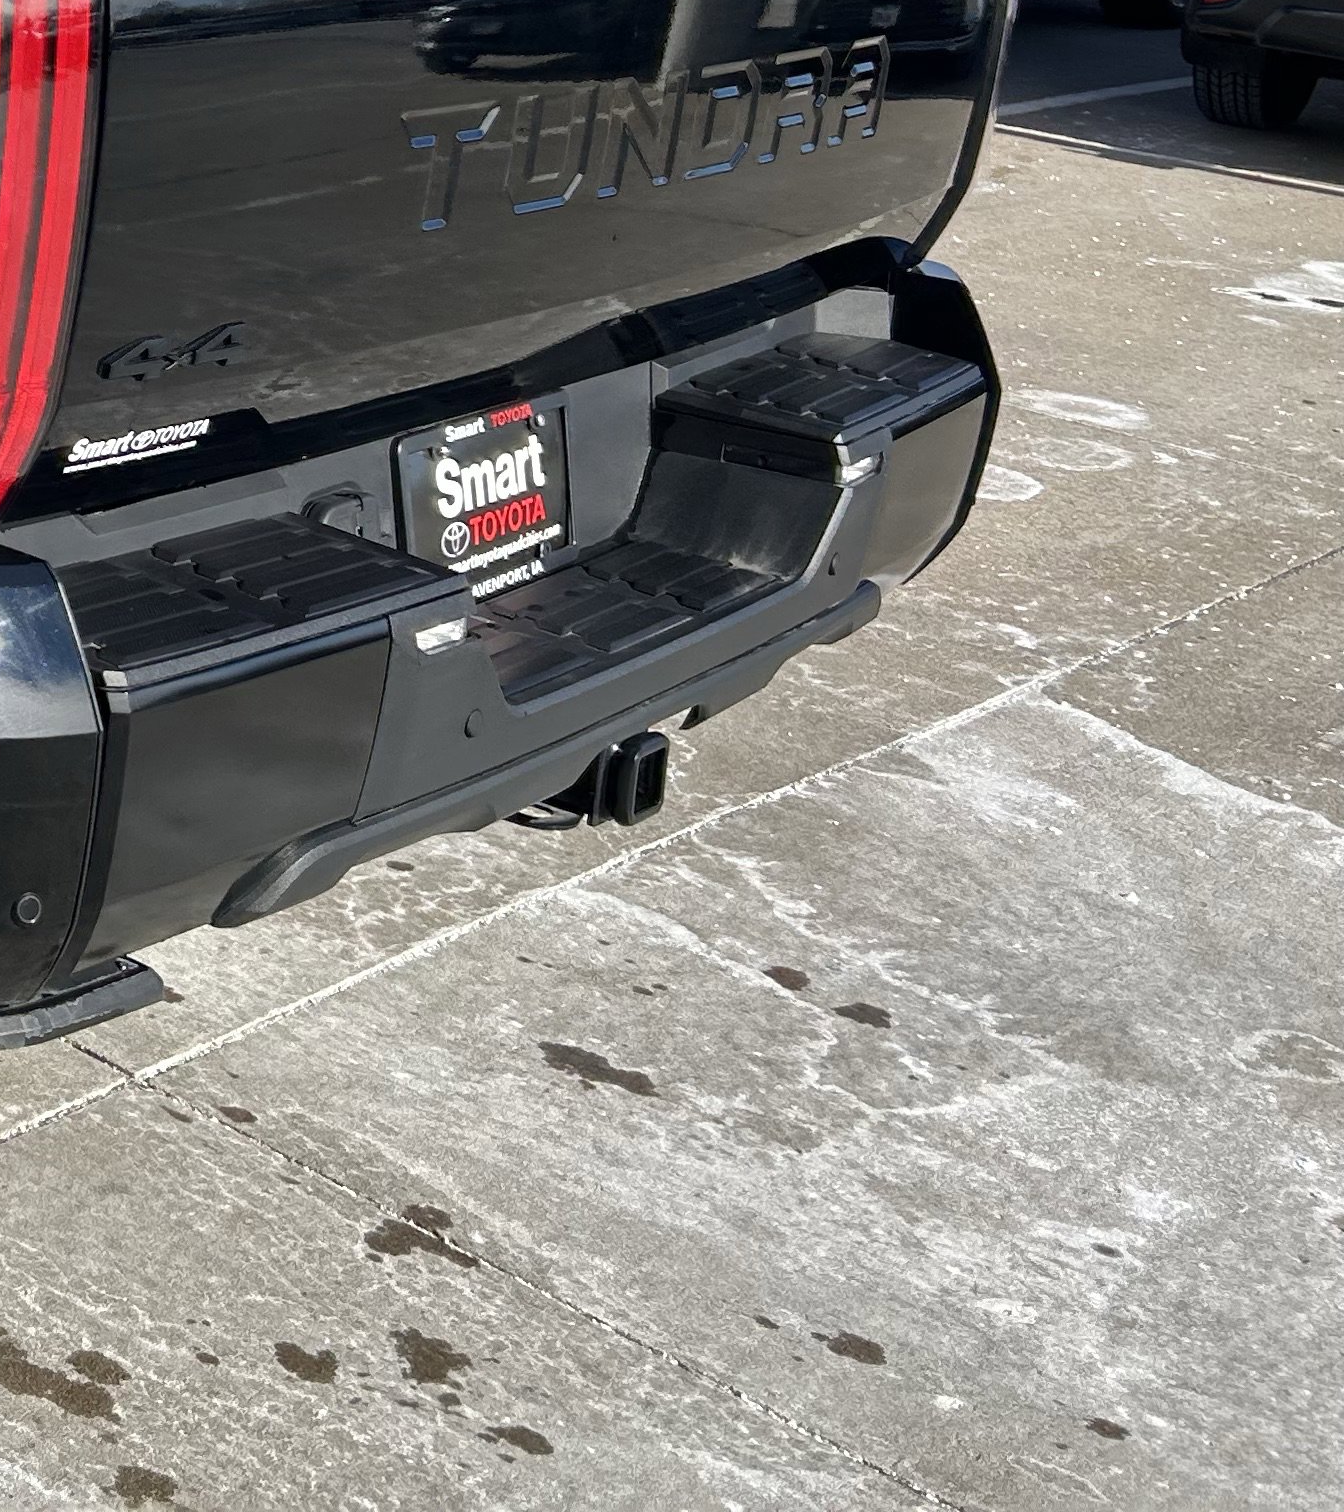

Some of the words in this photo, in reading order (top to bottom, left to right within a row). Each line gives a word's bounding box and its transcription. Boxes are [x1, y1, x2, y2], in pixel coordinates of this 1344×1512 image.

[401, 35, 889, 231] TUNDRA
[68, 430, 134, 462] Smart
[151, 418, 210, 445] TOYOTA
[445, 416, 485, 442] Smart
[489, 403, 533, 428] TOYOTA
[436, 434, 545, 519] Smart
[469, 493, 547, 546] TOYOTA
[531, 559, 545, 576] IA
